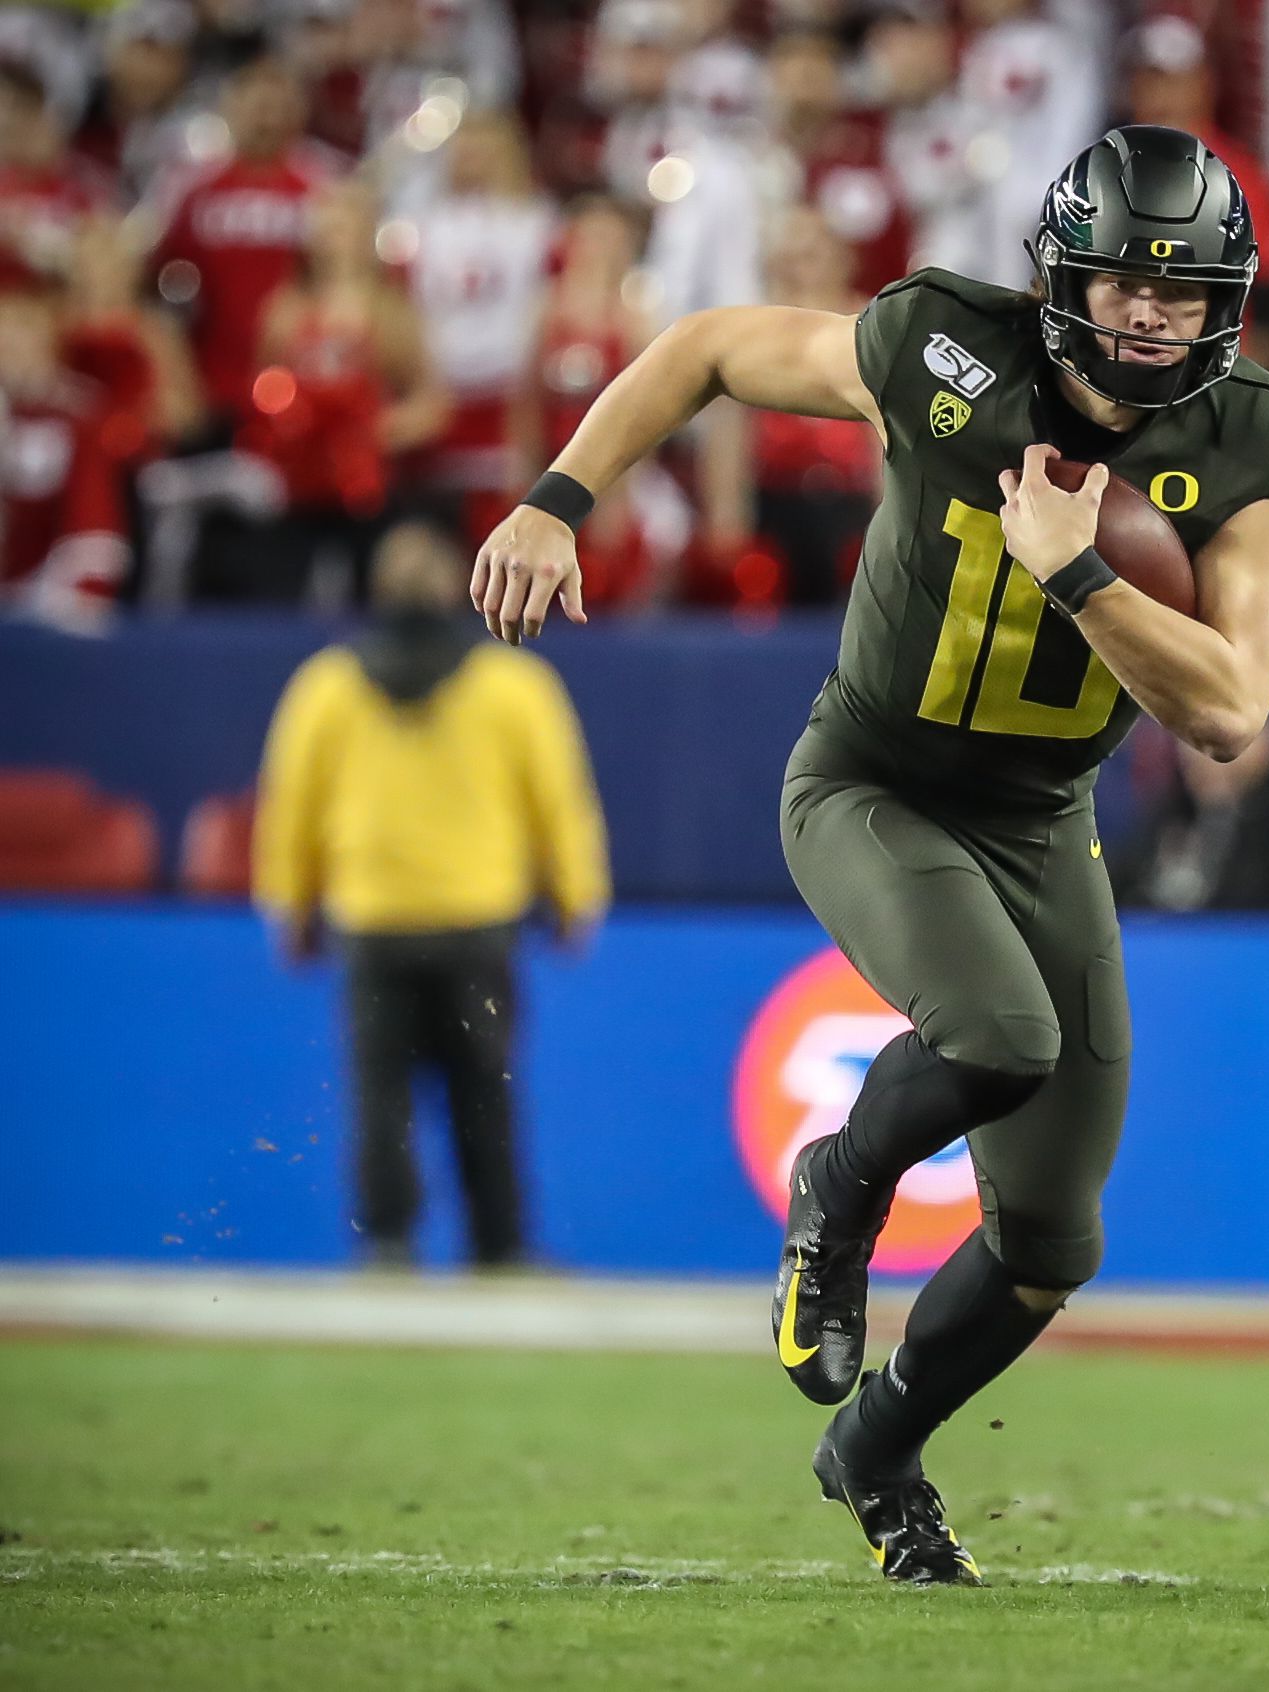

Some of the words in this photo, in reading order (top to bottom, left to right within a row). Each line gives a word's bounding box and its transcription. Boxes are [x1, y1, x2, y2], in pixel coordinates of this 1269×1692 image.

[924, 333, 997, 399] 150
[933, 411, 954, 433] 12
[1150, 471, 1199, 512] O
[917, 498, 1121, 738] 10
